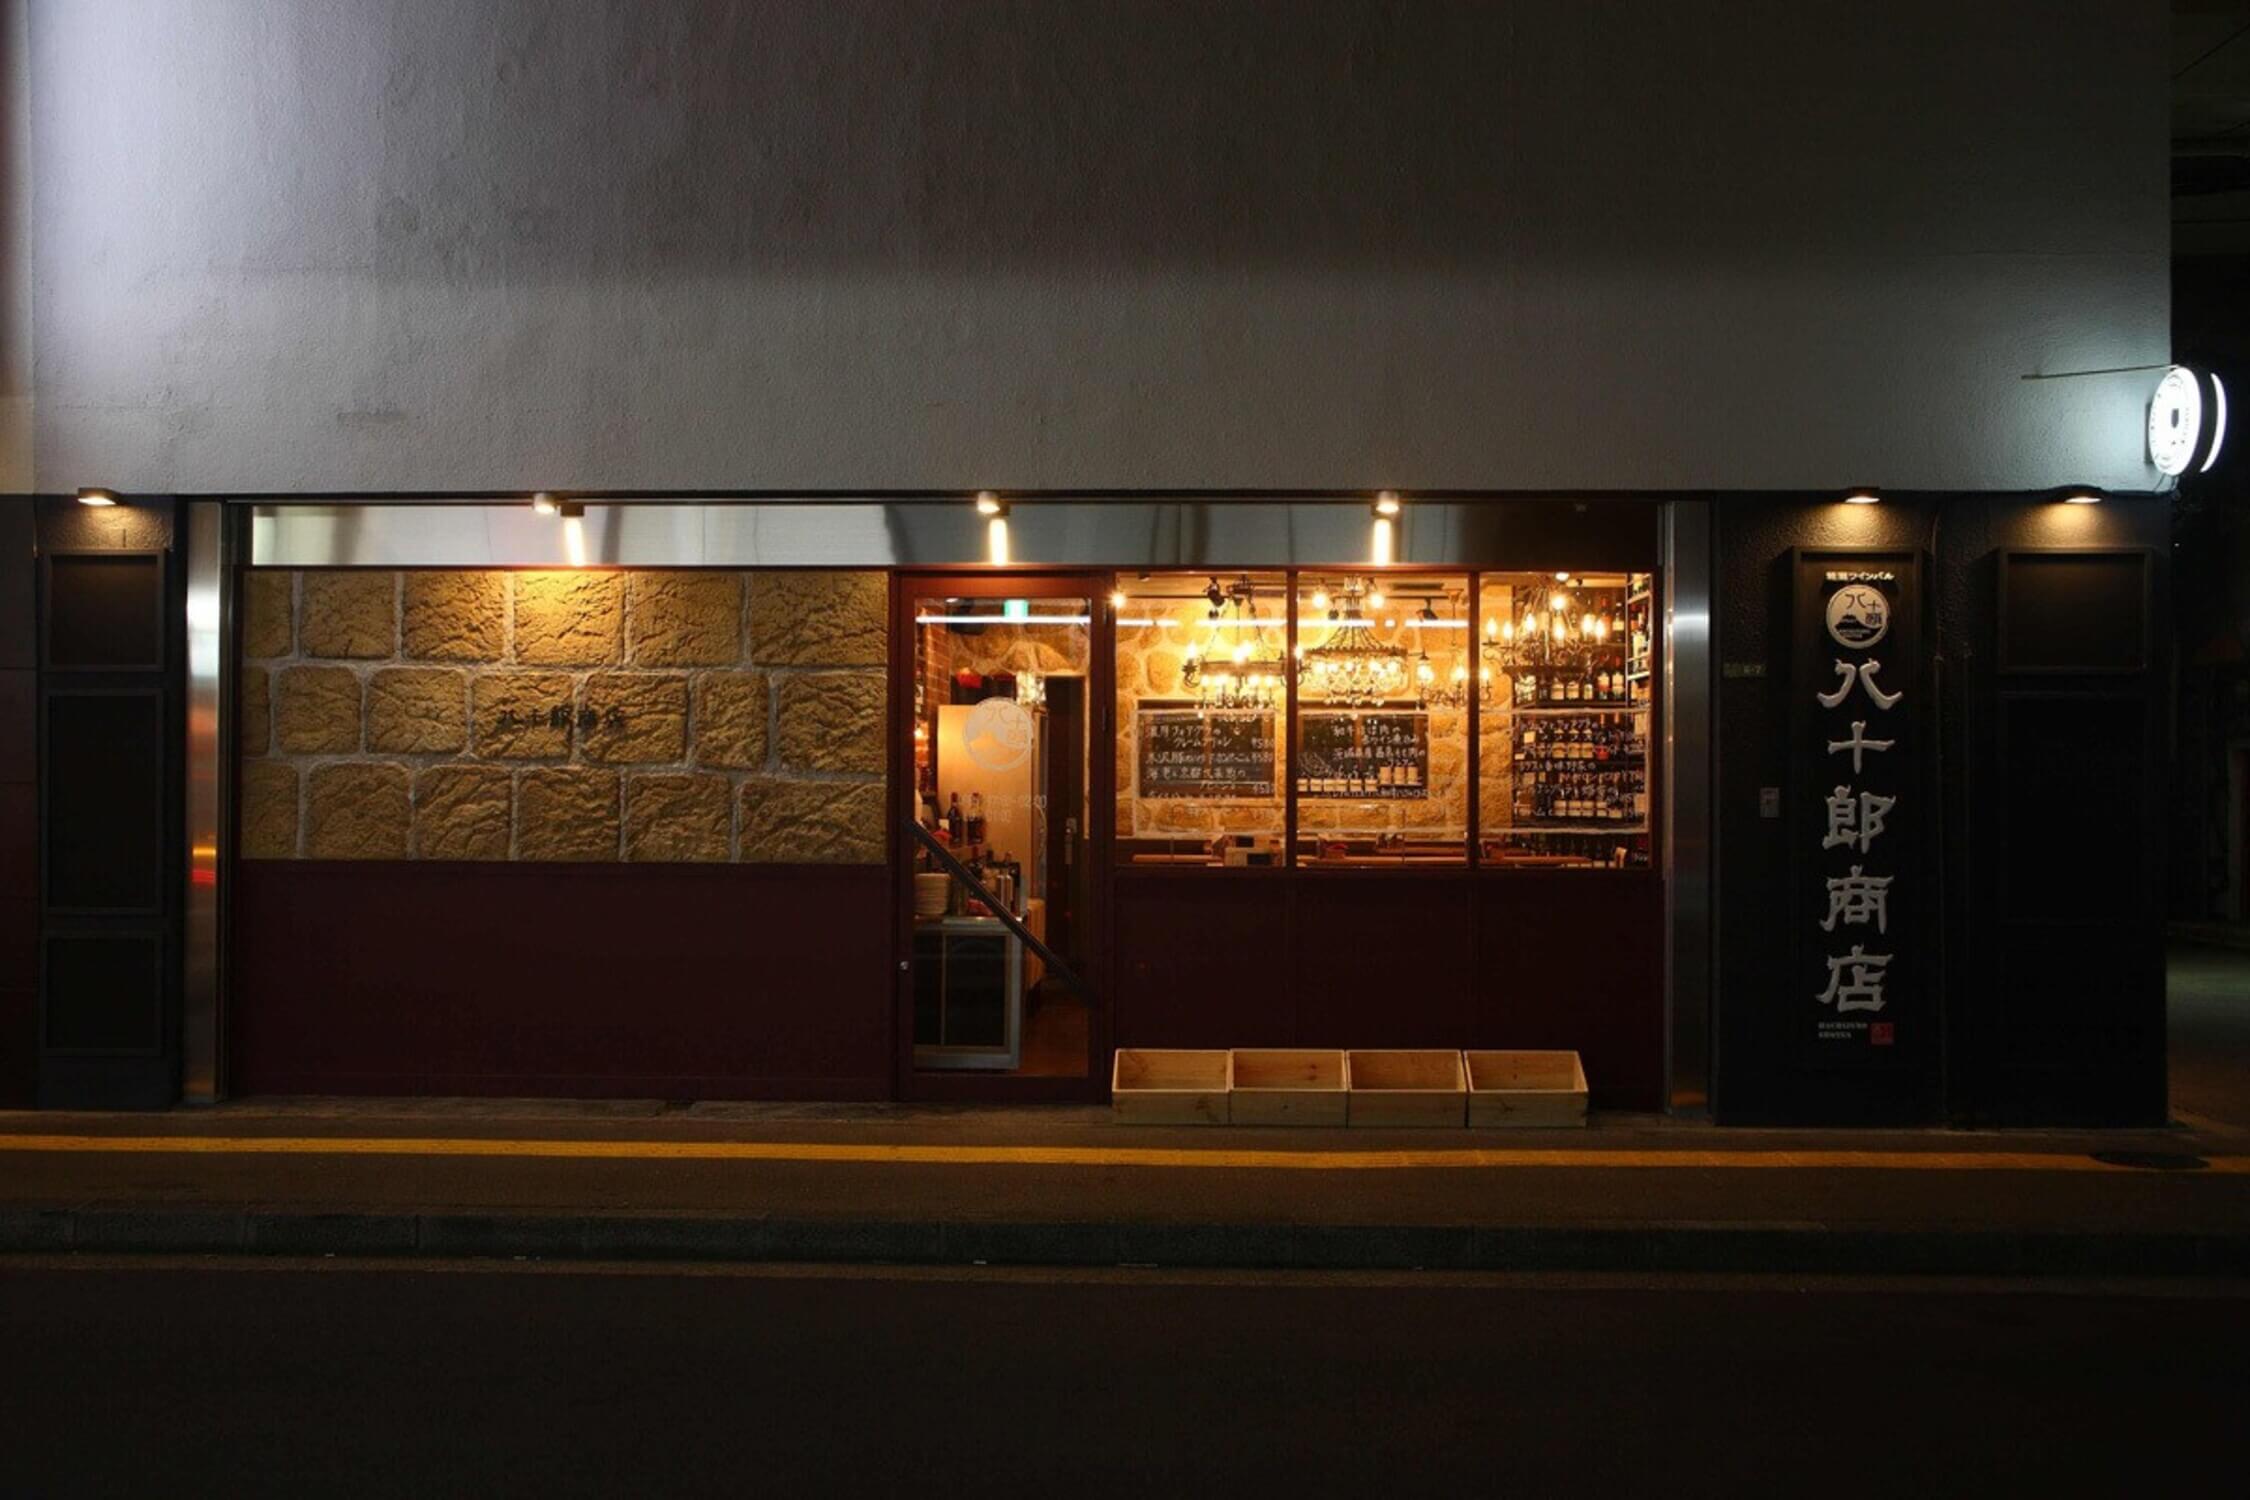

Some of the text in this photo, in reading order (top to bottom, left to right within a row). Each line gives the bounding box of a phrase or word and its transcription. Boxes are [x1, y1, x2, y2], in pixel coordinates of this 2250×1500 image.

[1815, 657, 1904, 1013] 八十郎商店
